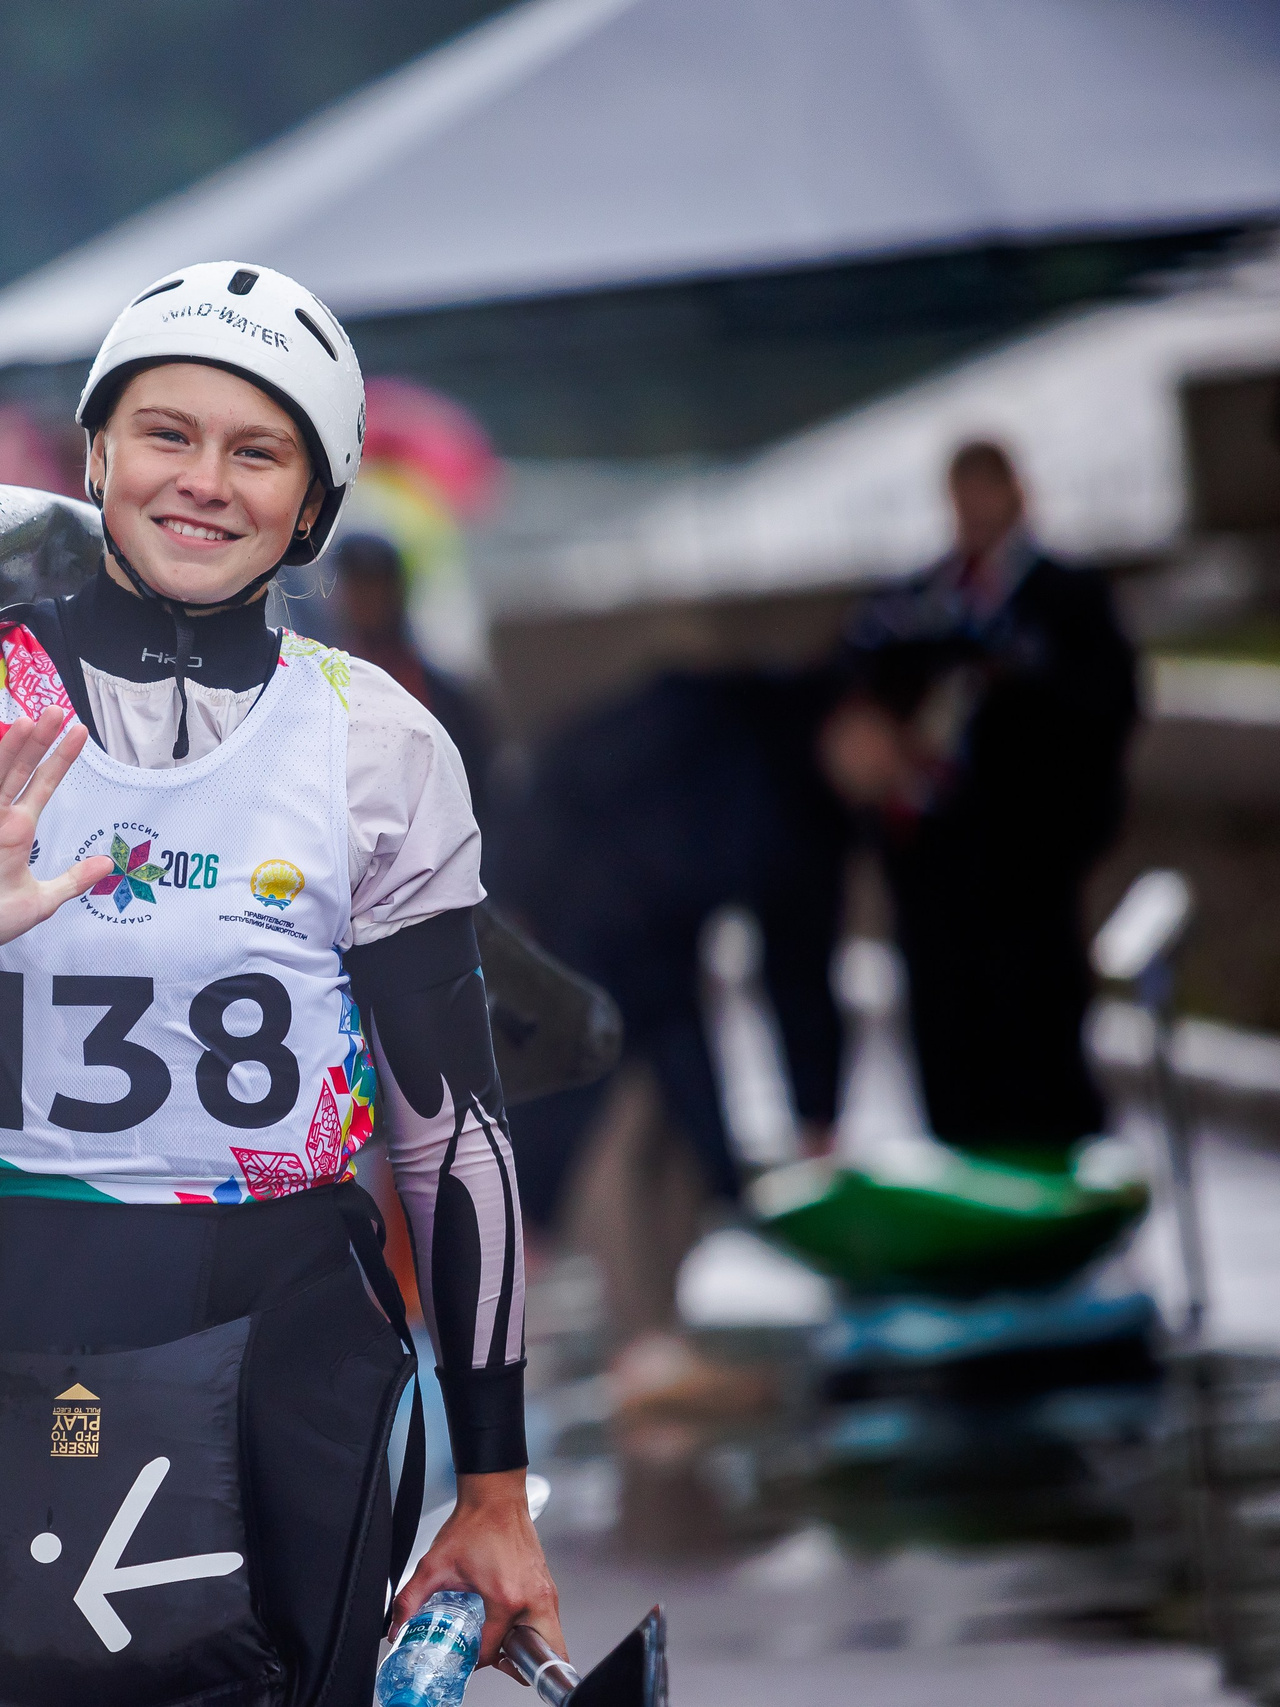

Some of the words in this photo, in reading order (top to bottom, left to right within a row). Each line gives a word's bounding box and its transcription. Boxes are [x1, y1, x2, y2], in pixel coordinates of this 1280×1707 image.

[113, 822, 159, 840] РОССИИ
[75, 829, 104, 861] РОДОВ
[158, 849, 219, 889] 2026
[80, 895, 152, 924] СПАРТАКИАД
[218, 914, 265, 929] РЕСПУБЛИКИ
[265, 923, 308, 941] БАШКОРТОСТАН
[243, 910, 295, 929] ПРАВИТЕЛЬСТВО
[52, 1415, 101, 1431] PLAY
[51, 1431, 68, 1442] TO
[75, 1431, 100, 1442] PFD
[50, 1442, 99, 1454] INSERT
